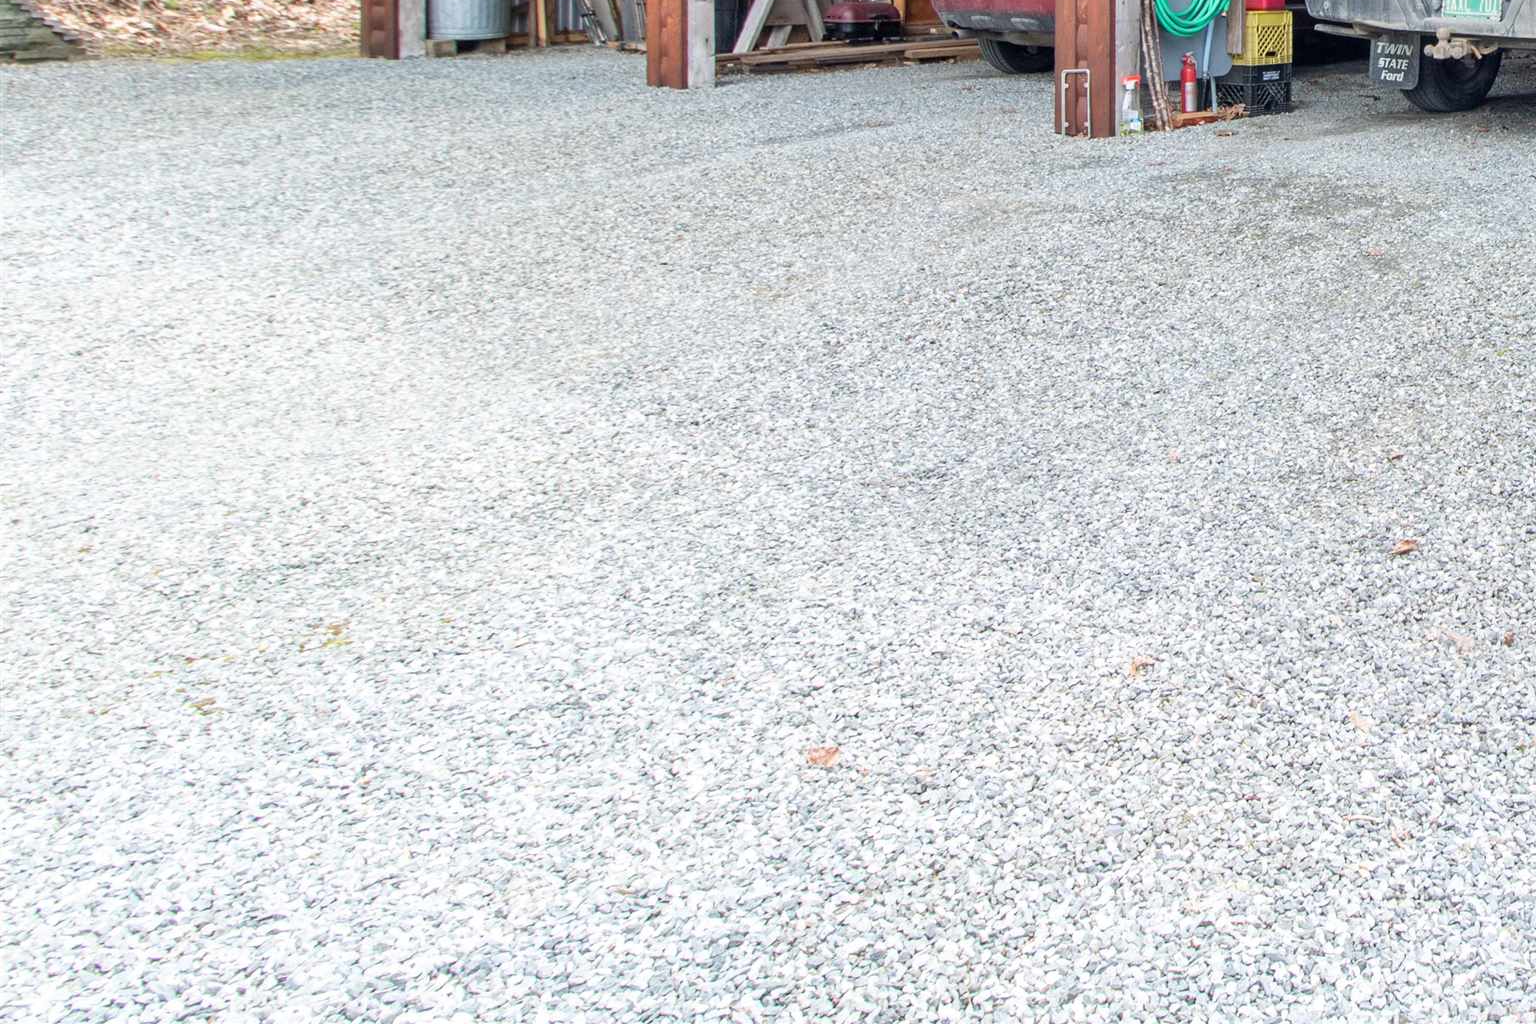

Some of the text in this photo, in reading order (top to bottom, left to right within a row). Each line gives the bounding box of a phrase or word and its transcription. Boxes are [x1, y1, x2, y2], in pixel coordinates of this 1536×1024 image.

[1376, 41, 1414, 56] TWIN
[1378, 57, 1409, 70] STATE
[1380, 69, 1405, 82] Ford
